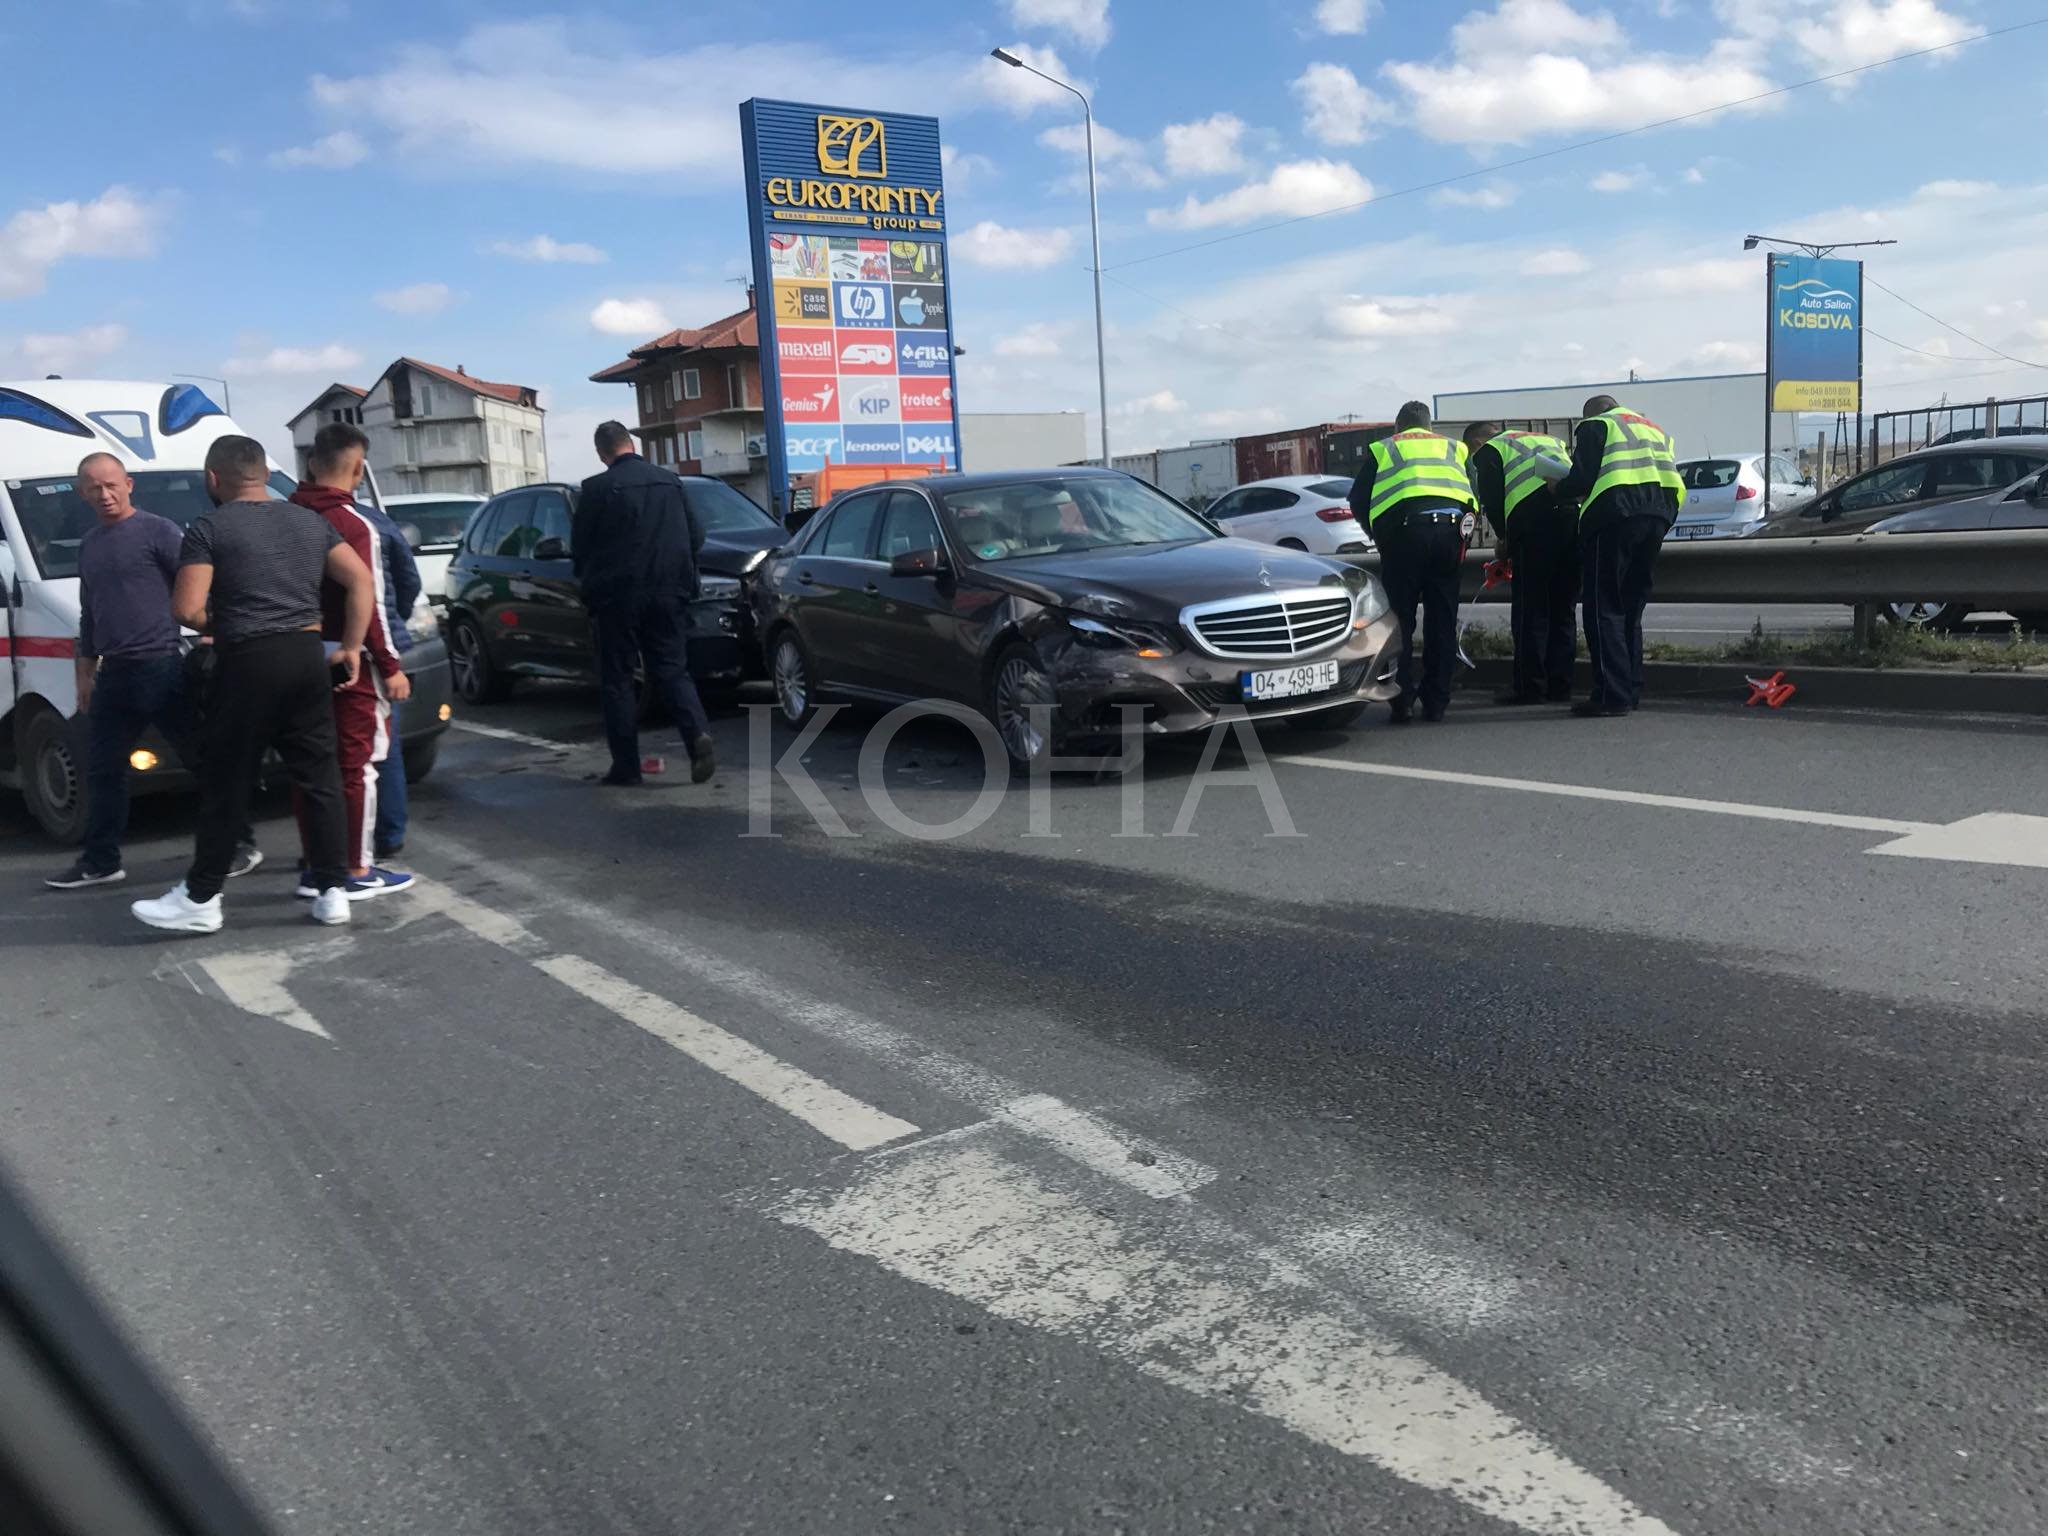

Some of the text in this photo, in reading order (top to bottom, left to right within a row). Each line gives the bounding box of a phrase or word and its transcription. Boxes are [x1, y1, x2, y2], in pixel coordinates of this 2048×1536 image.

[767, 177, 942, 215] EUROPRINTY
[873, 216, 916, 231] group
[804, 293, 826, 303] case
[854, 287, 874, 319] hp
[1800, 298, 1822, 309] Auto
[804, 303, 827, 313] LOGIC
[924, 302, 944, 315] Apple
[1780, 308, 1853, 330] KOSOVA
[779, 341, 832, 357] maxell
[783, 397, 818, 411] Genius
[860, 398, 891, 414] KIP
[902, 393, 941, 406] trotec
[786, 438, 838, 456] acer
[846, 441, 900, 452] lenovo
[907, 436, 955, 455] DELL
[1256, 673, 1275, 693] 04
